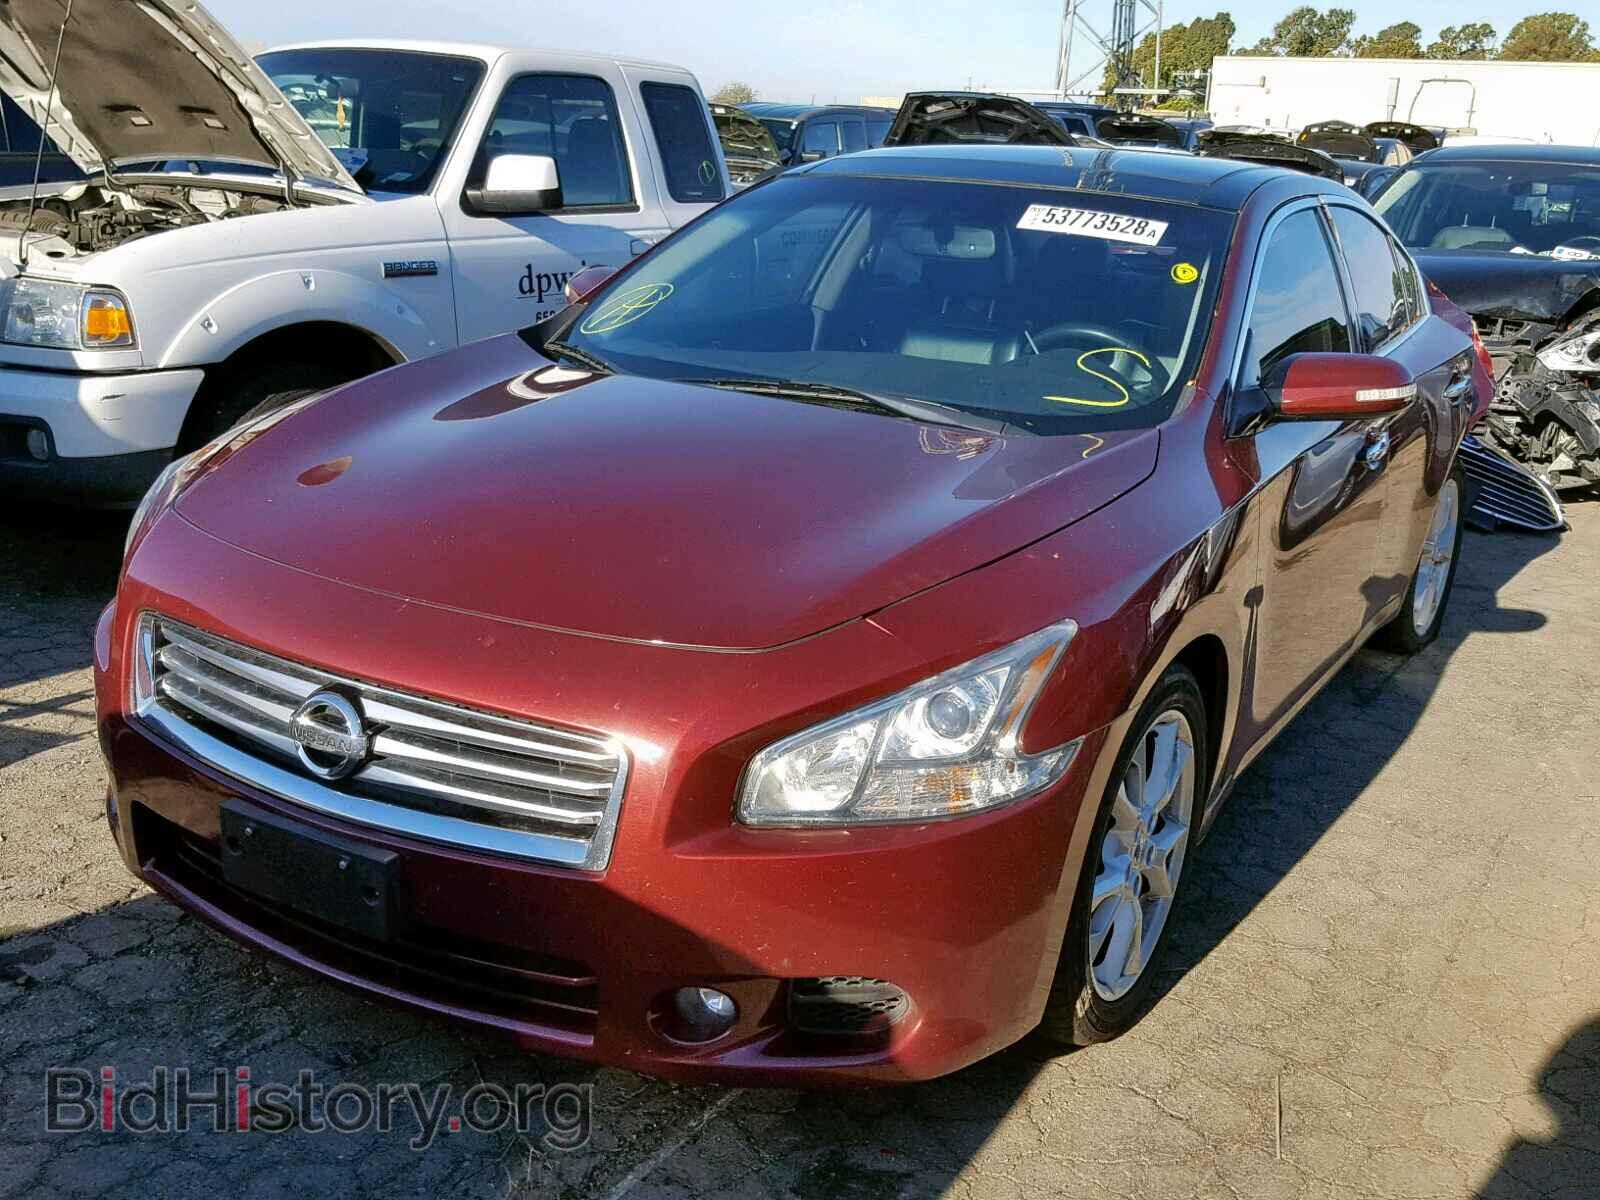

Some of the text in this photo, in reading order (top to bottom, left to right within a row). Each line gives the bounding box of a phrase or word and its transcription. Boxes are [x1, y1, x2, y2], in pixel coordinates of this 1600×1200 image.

[1041, 207, 1150, 236] 53773528
[518, 260, 587, 304] dpw
[291, 722, 358, 754] NISSAN
